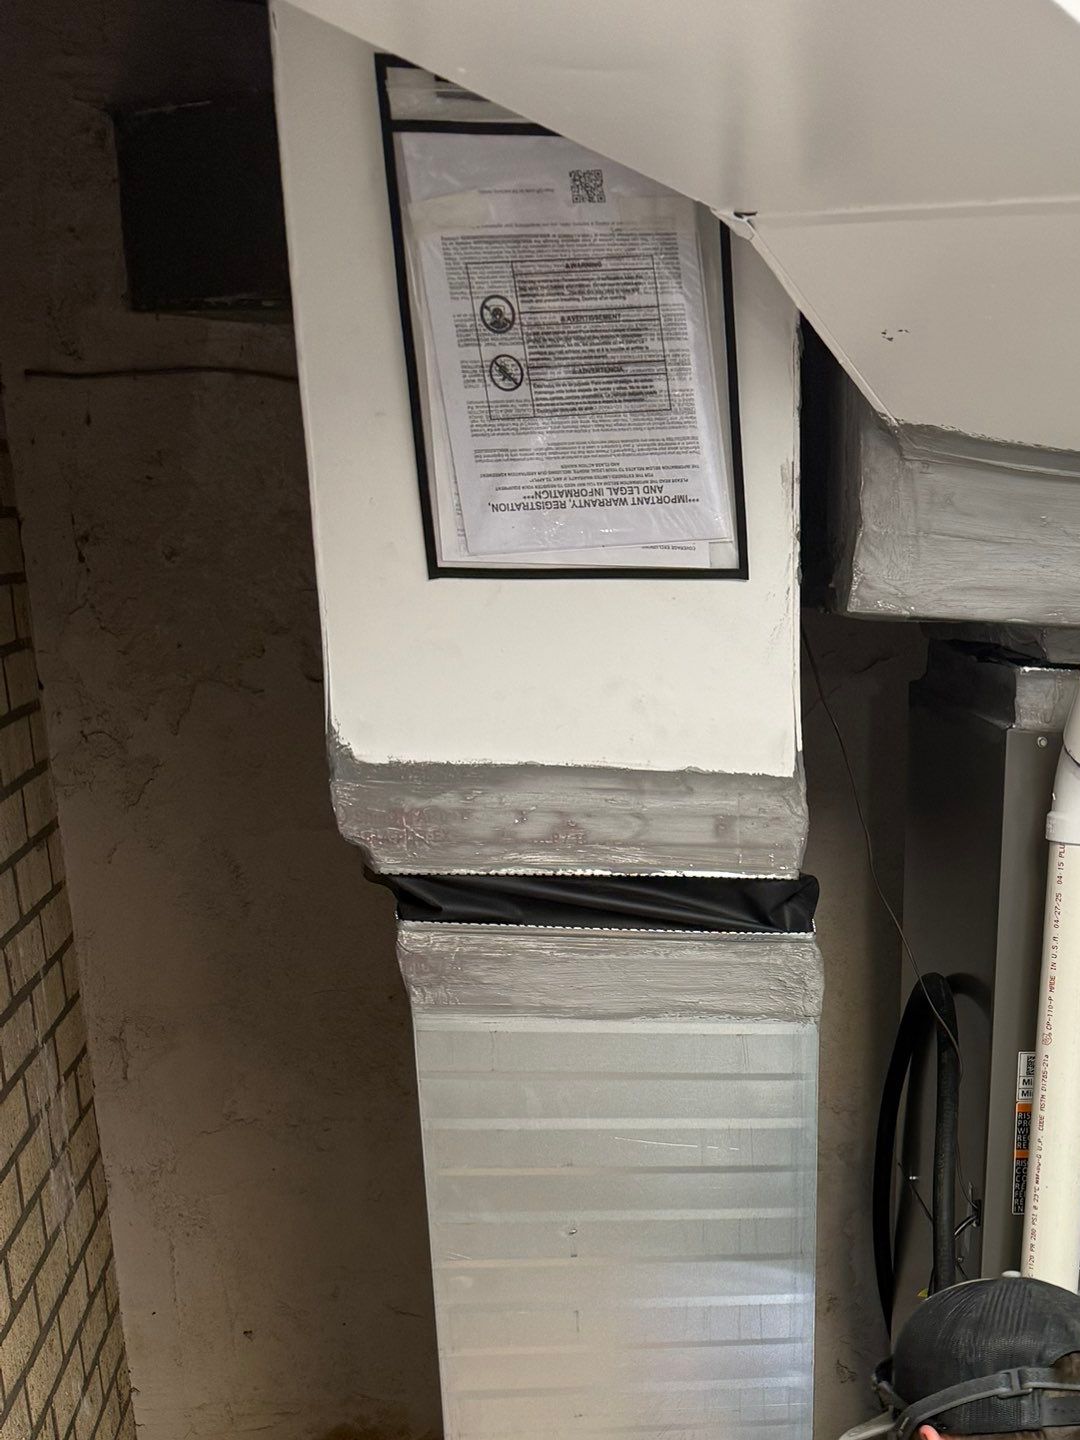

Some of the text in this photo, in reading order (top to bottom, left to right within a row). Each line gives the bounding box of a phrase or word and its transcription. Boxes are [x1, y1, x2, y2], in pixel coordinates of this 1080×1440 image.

[606, 486, 640, 495] LEGAL
[643, 485, 663, 493] AND
[488, 501, 566, 512] REGISTRATION,
[572, 497, 628, 508] WARRANTY,
[1048, 976, 1057, 993] MADE
